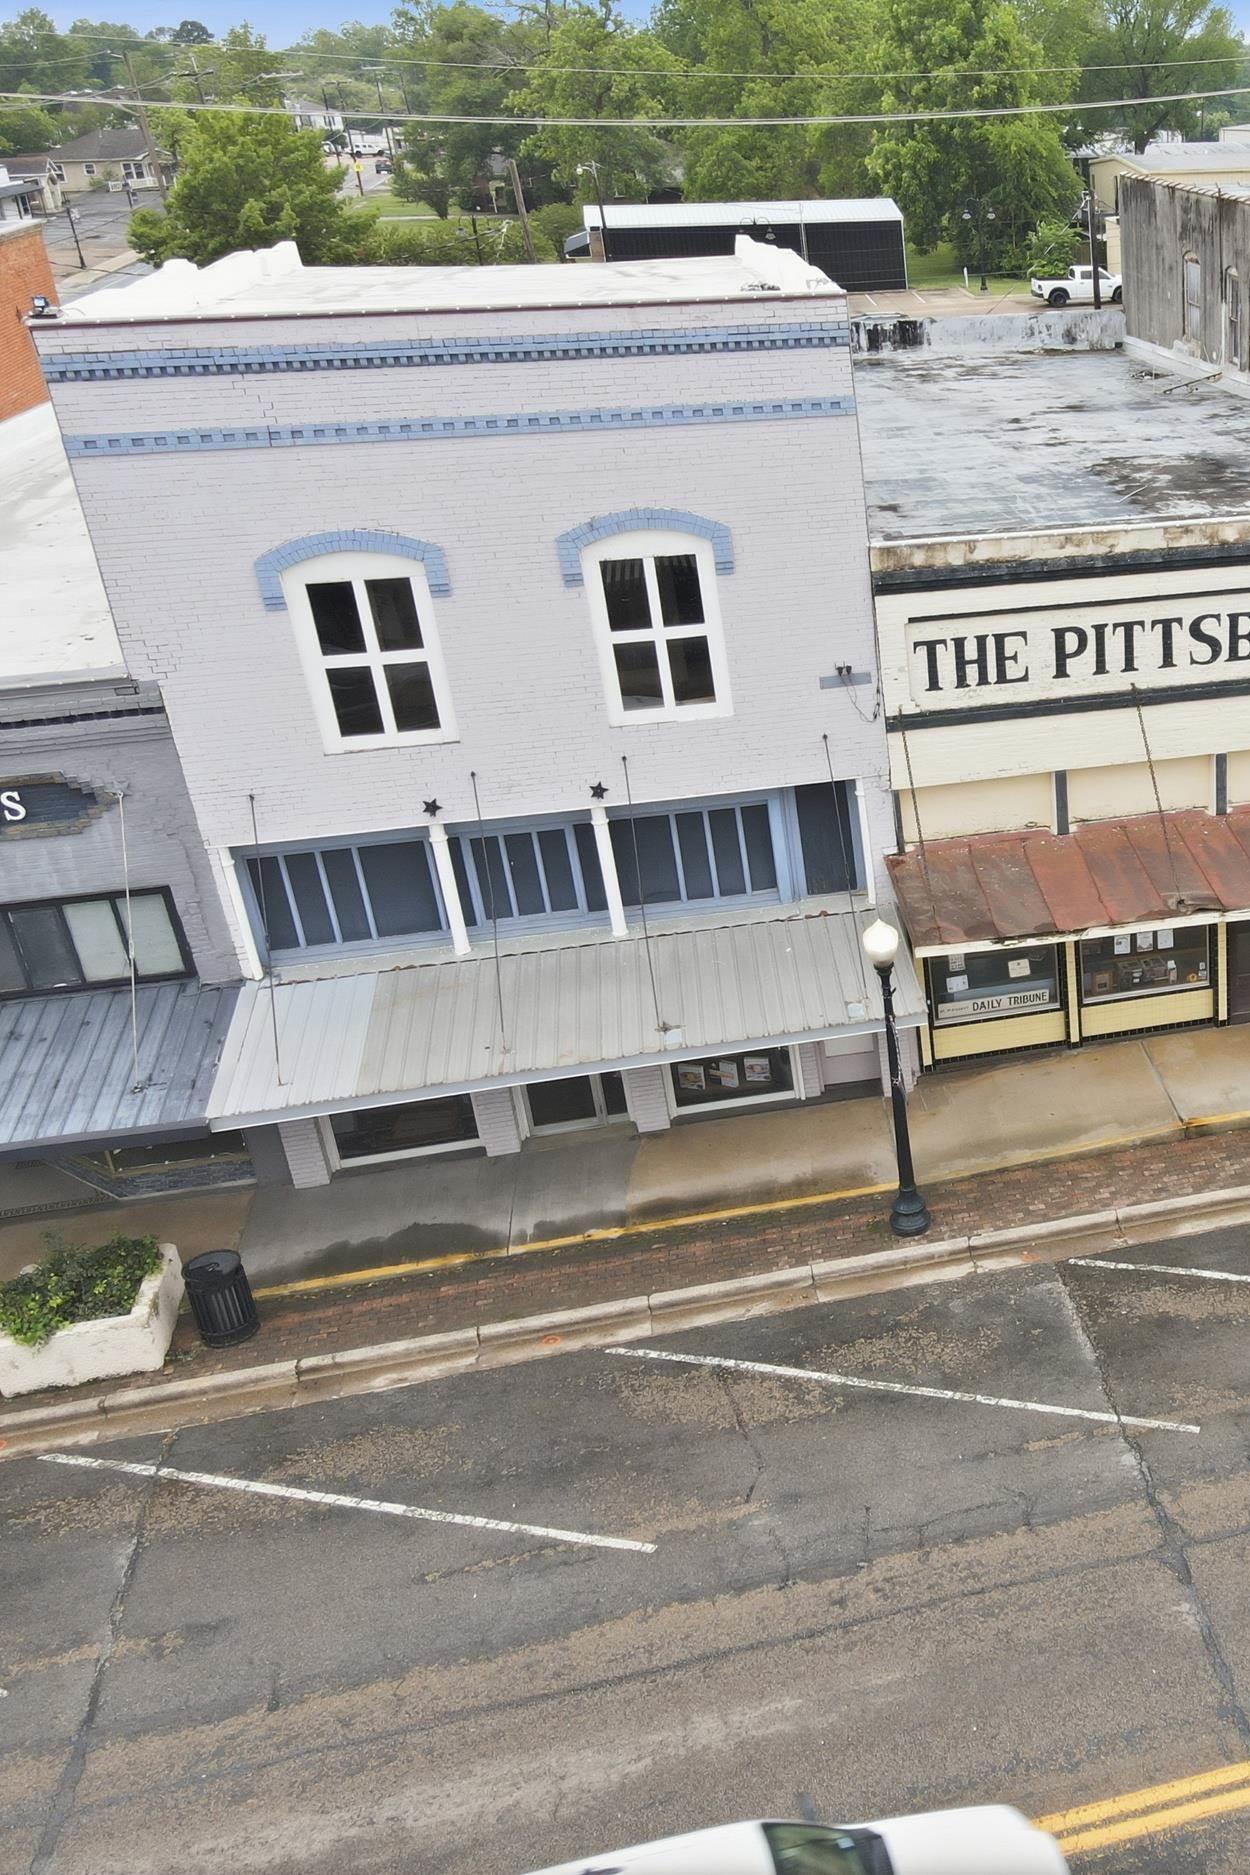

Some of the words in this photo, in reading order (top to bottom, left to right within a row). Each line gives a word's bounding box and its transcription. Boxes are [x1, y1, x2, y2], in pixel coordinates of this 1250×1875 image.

[913, 631, 1029, 691] THE
[0, 791, 26, 821] S
[972, 998, 1002, 1011] DAILY
[1007, 991, 1047, 1006] TRIBUNE
